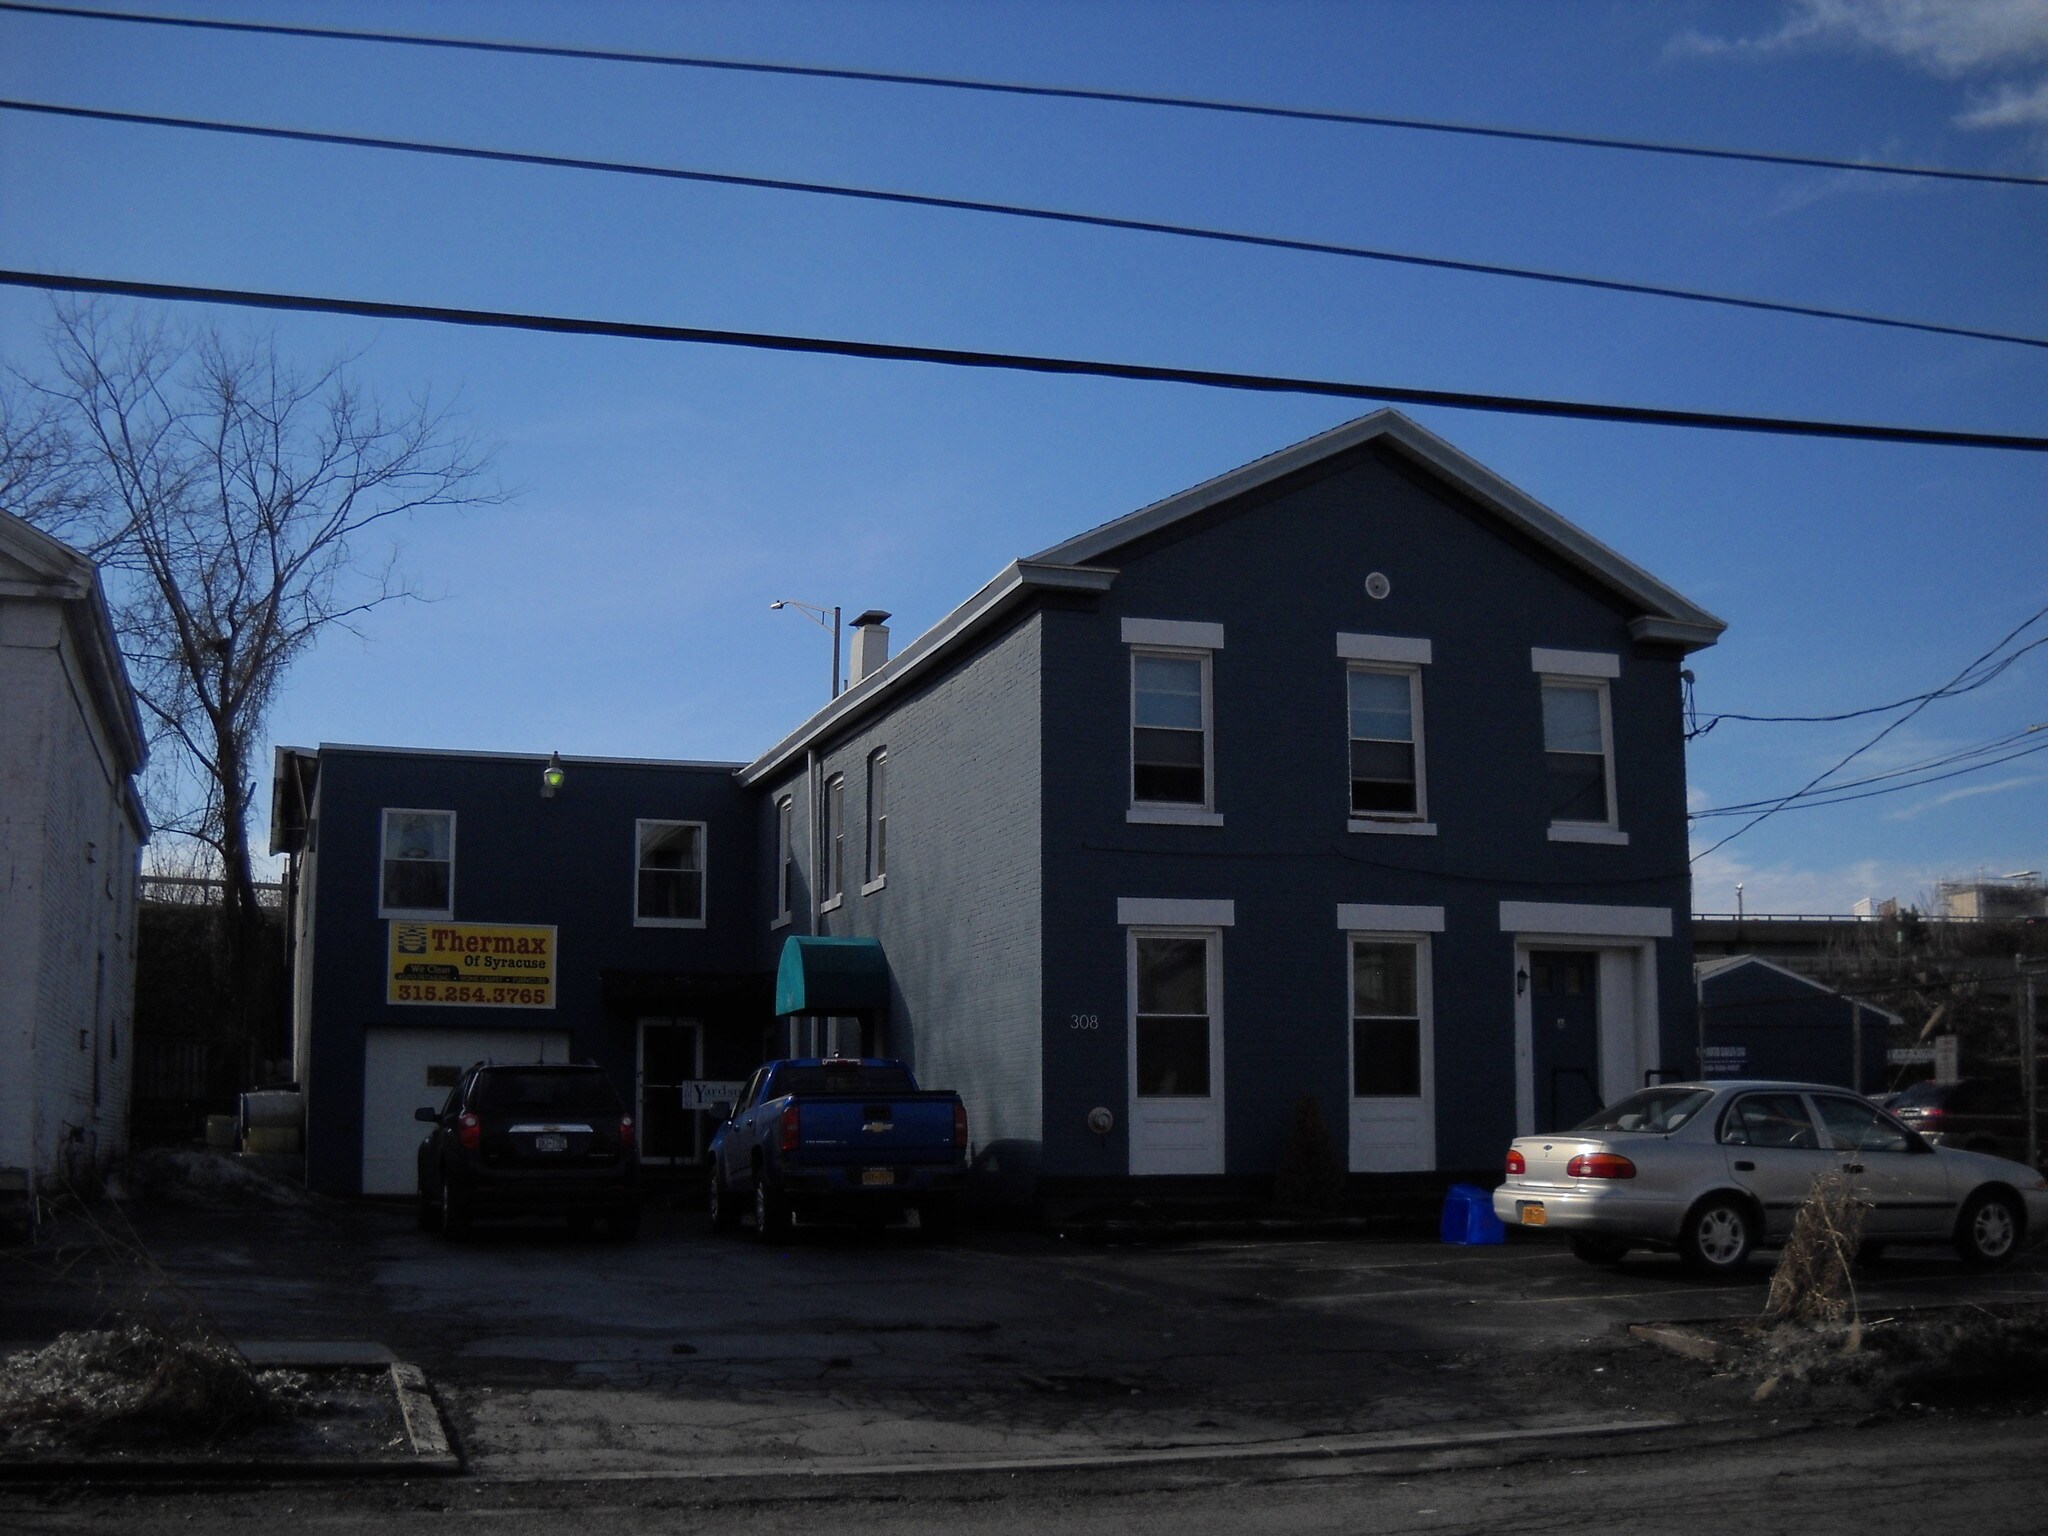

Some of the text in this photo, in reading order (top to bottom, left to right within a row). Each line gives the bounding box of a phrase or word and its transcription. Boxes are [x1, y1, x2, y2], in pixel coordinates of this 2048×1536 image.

[432, 929, 546, 954] Thermax
[411, 965, 451, 973] We Clean
[464, 955, 546, 970] Of Syracuse
[398, 985, 545, 1004] 315.254.3765
[1070, 1014, 1099, 1030] 308
